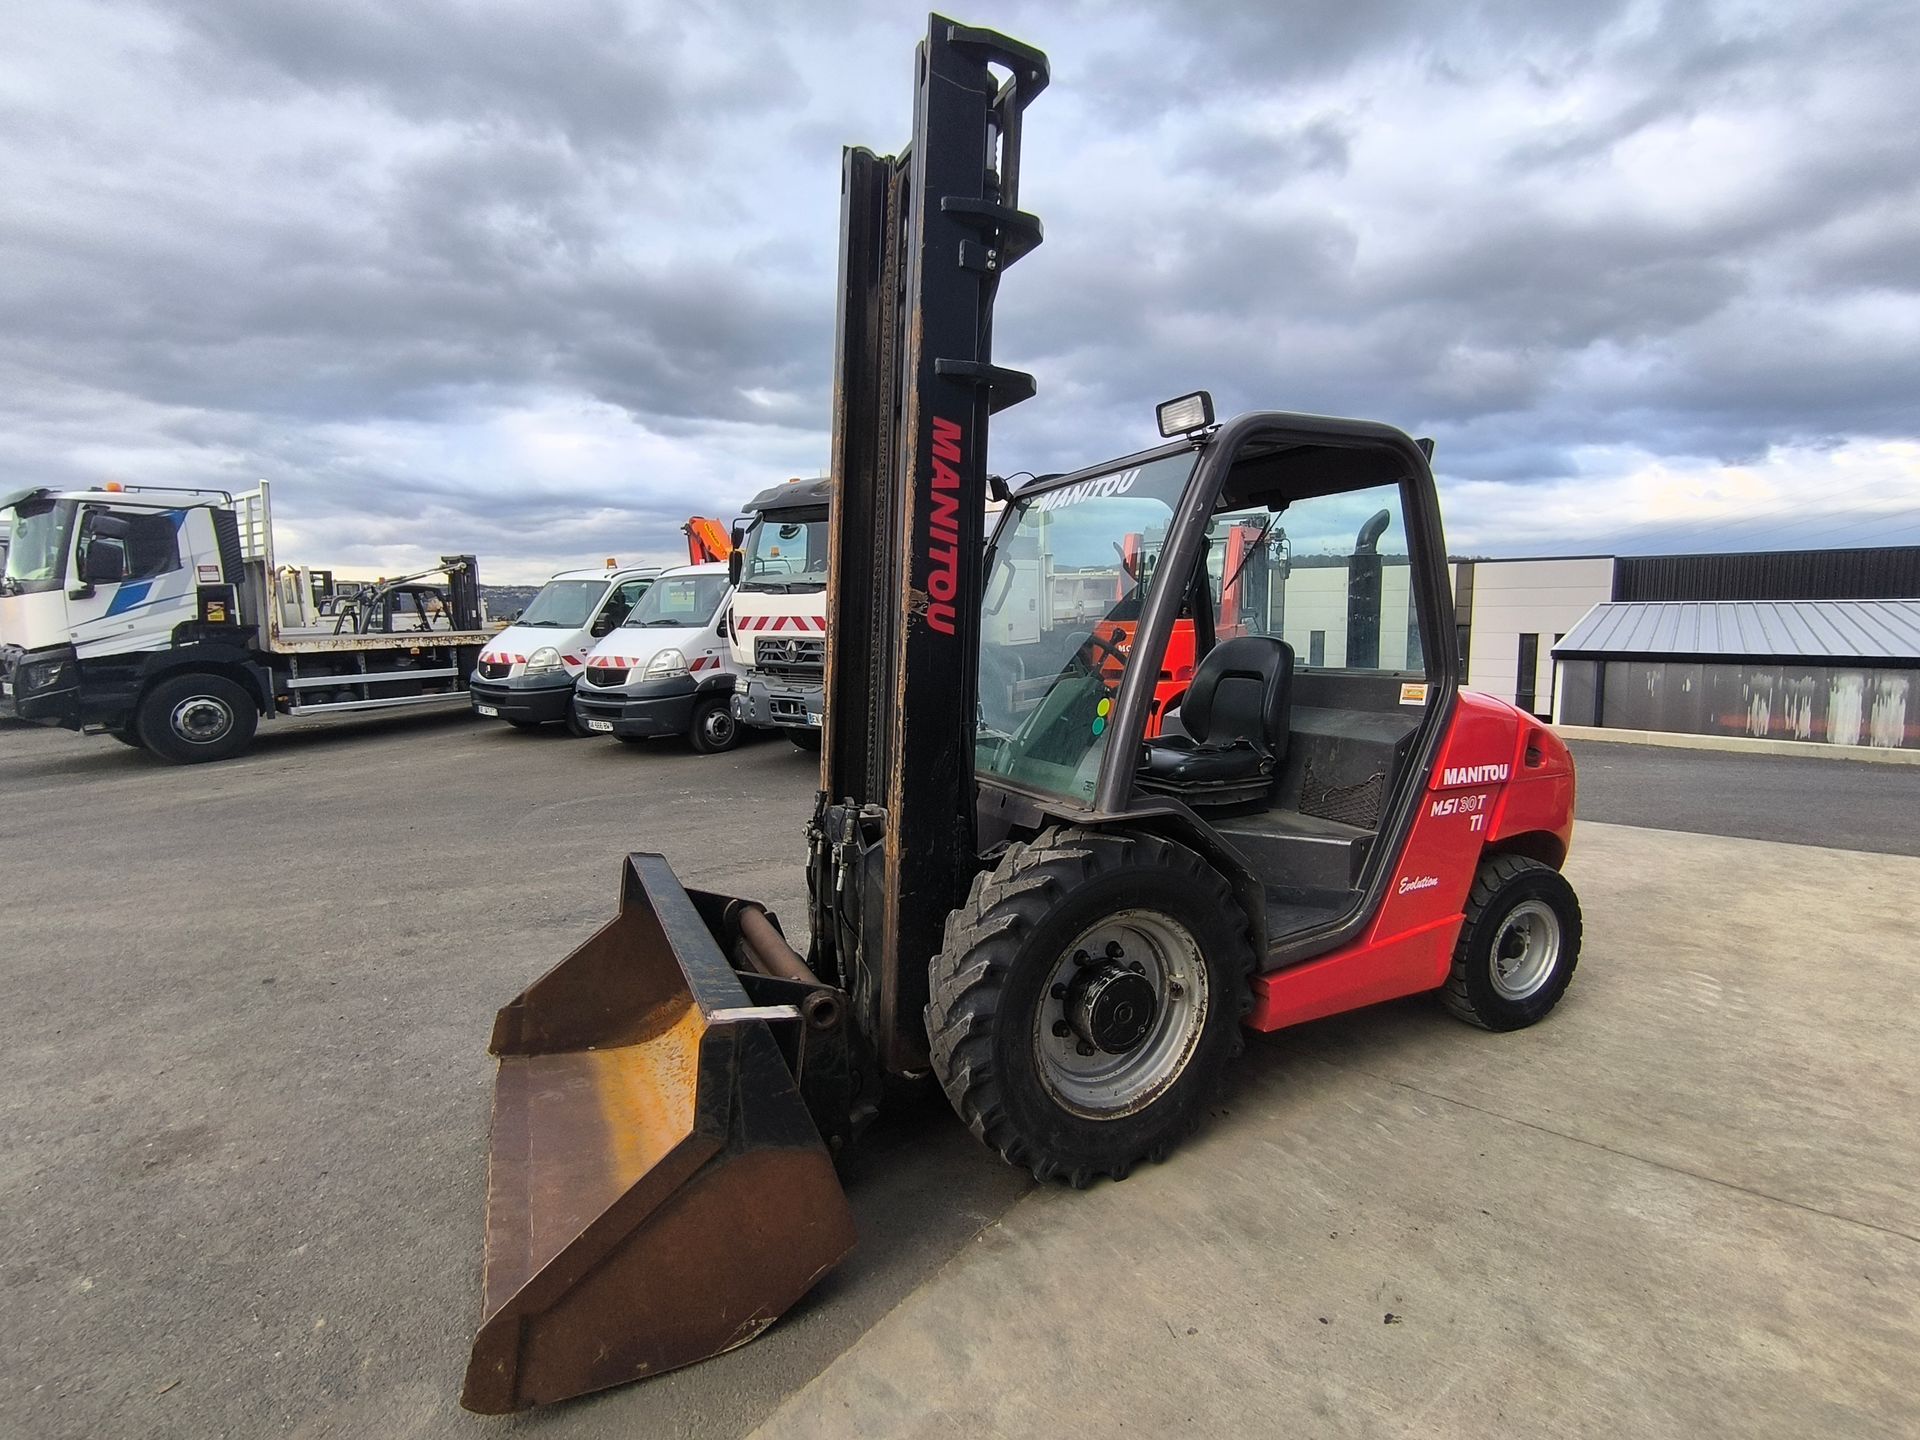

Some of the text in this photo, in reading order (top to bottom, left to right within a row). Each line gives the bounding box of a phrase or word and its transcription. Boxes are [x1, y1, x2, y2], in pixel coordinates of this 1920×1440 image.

[1035, 468, 1141, 513] MANITOU
[927, 416, 961, 635] MANITOU
[1443, 764, 1509, 785] MANITOU
[1398, 875, 1439, 895] Evolution
